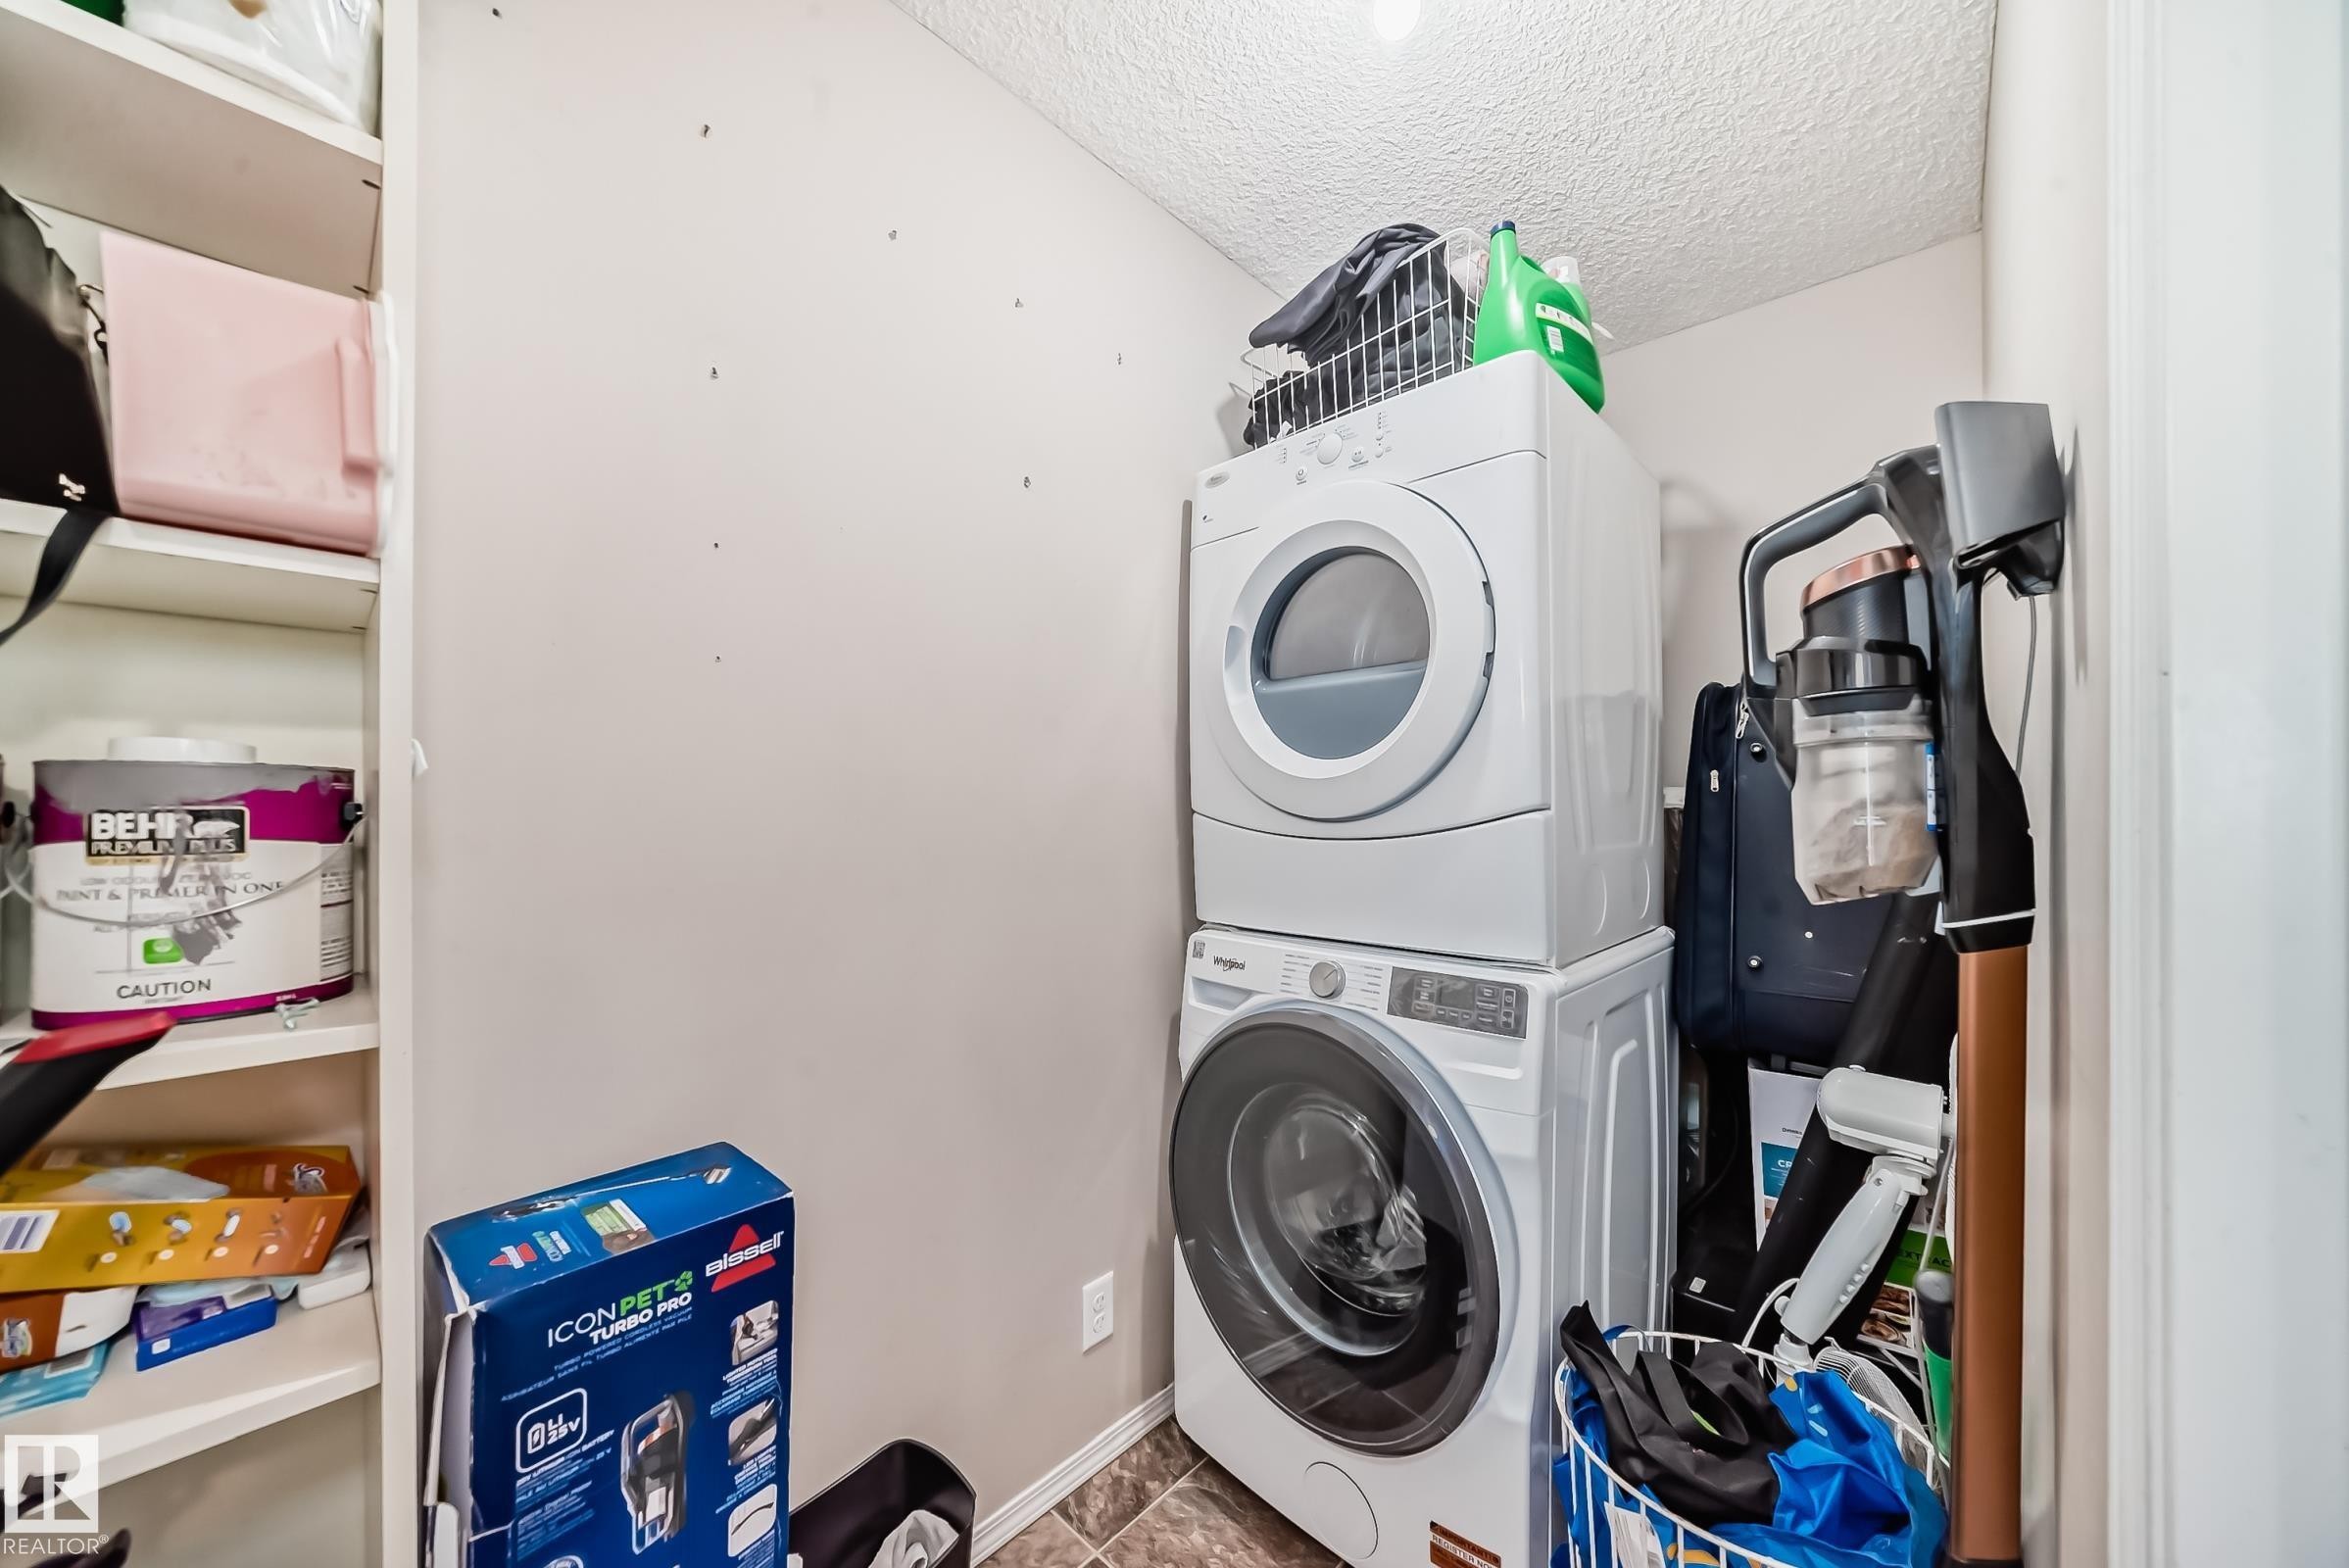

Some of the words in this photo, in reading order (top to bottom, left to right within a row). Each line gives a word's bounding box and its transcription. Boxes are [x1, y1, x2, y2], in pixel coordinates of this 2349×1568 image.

[91, 811, 196, 839] BEHR
[106, 889, 122, 901] &
[1213, 956, 1247, 971] Whirlpool
[117, 979, 212, 999] CAUTION
[548, 1302, 616, 1348] ICON
[620, 1282, 668, 1316] PET
[589, 1308, 653, 1345] TURBO
[657, 1292, 693, 1317] PRO
[547, 1417, 581, 1446] 25V
[1432, 1534, 1475, 1564] REGISTER
